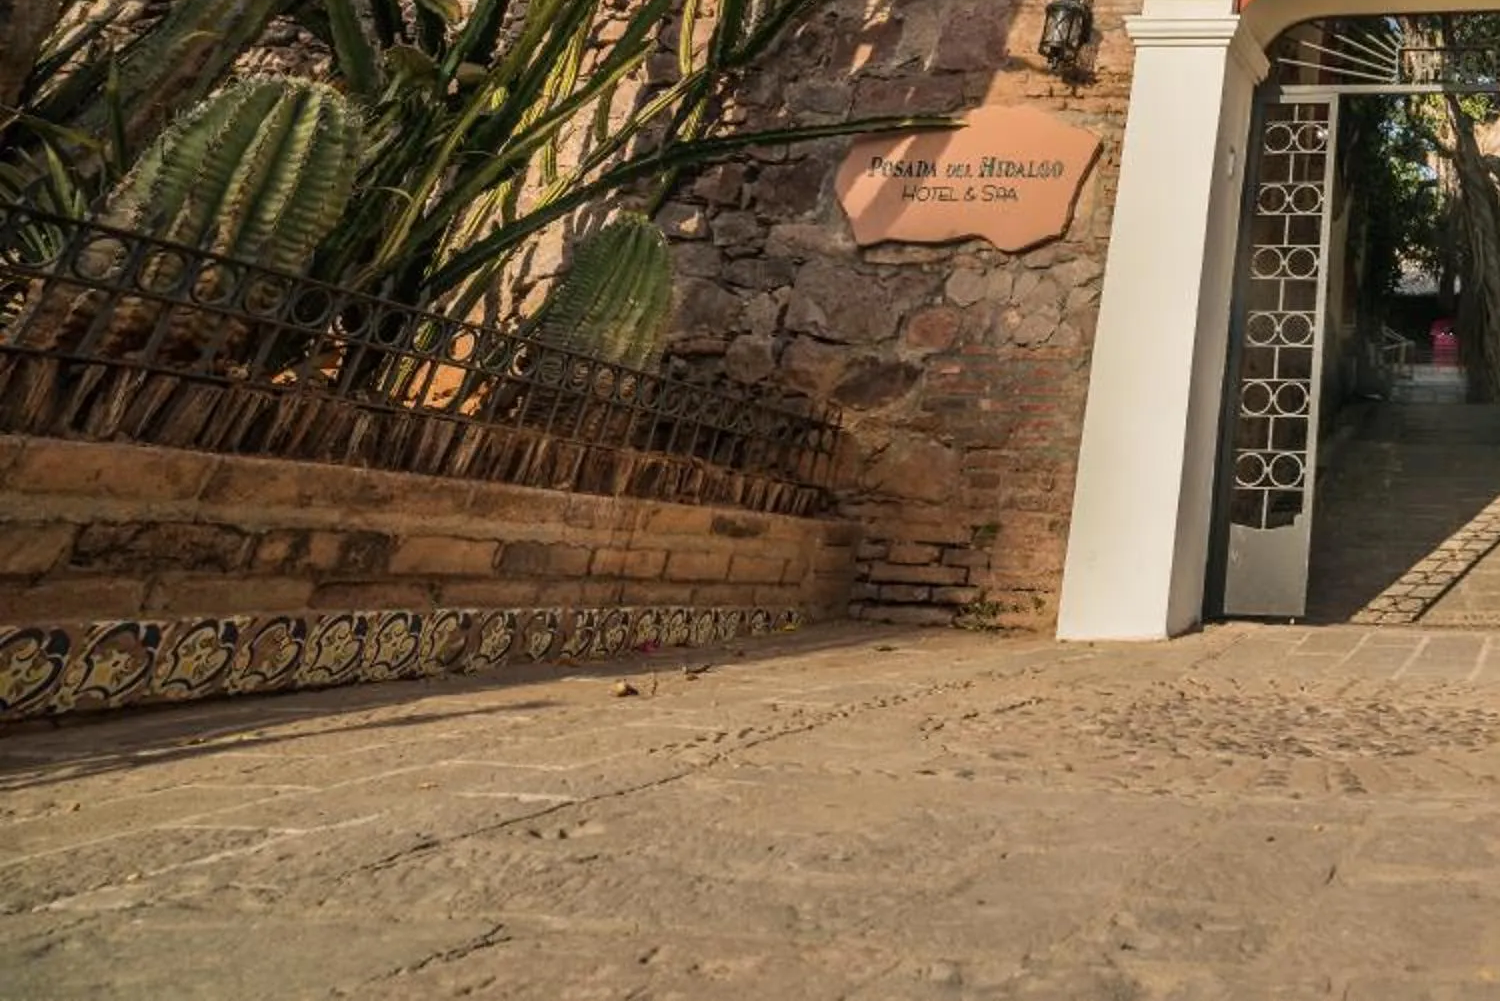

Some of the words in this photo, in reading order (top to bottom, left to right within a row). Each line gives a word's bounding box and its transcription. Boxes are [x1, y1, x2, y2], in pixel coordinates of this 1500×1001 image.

[868, 156, 937, 178] POSADA
[947, 162, 973, 178] DEL
[977, 156, 1065, 180] HIDALGO
[902, 185, 960, 202] HOTEL
[963, 186, 977, 202] &
[981, 184, 1019, 202] SPA
